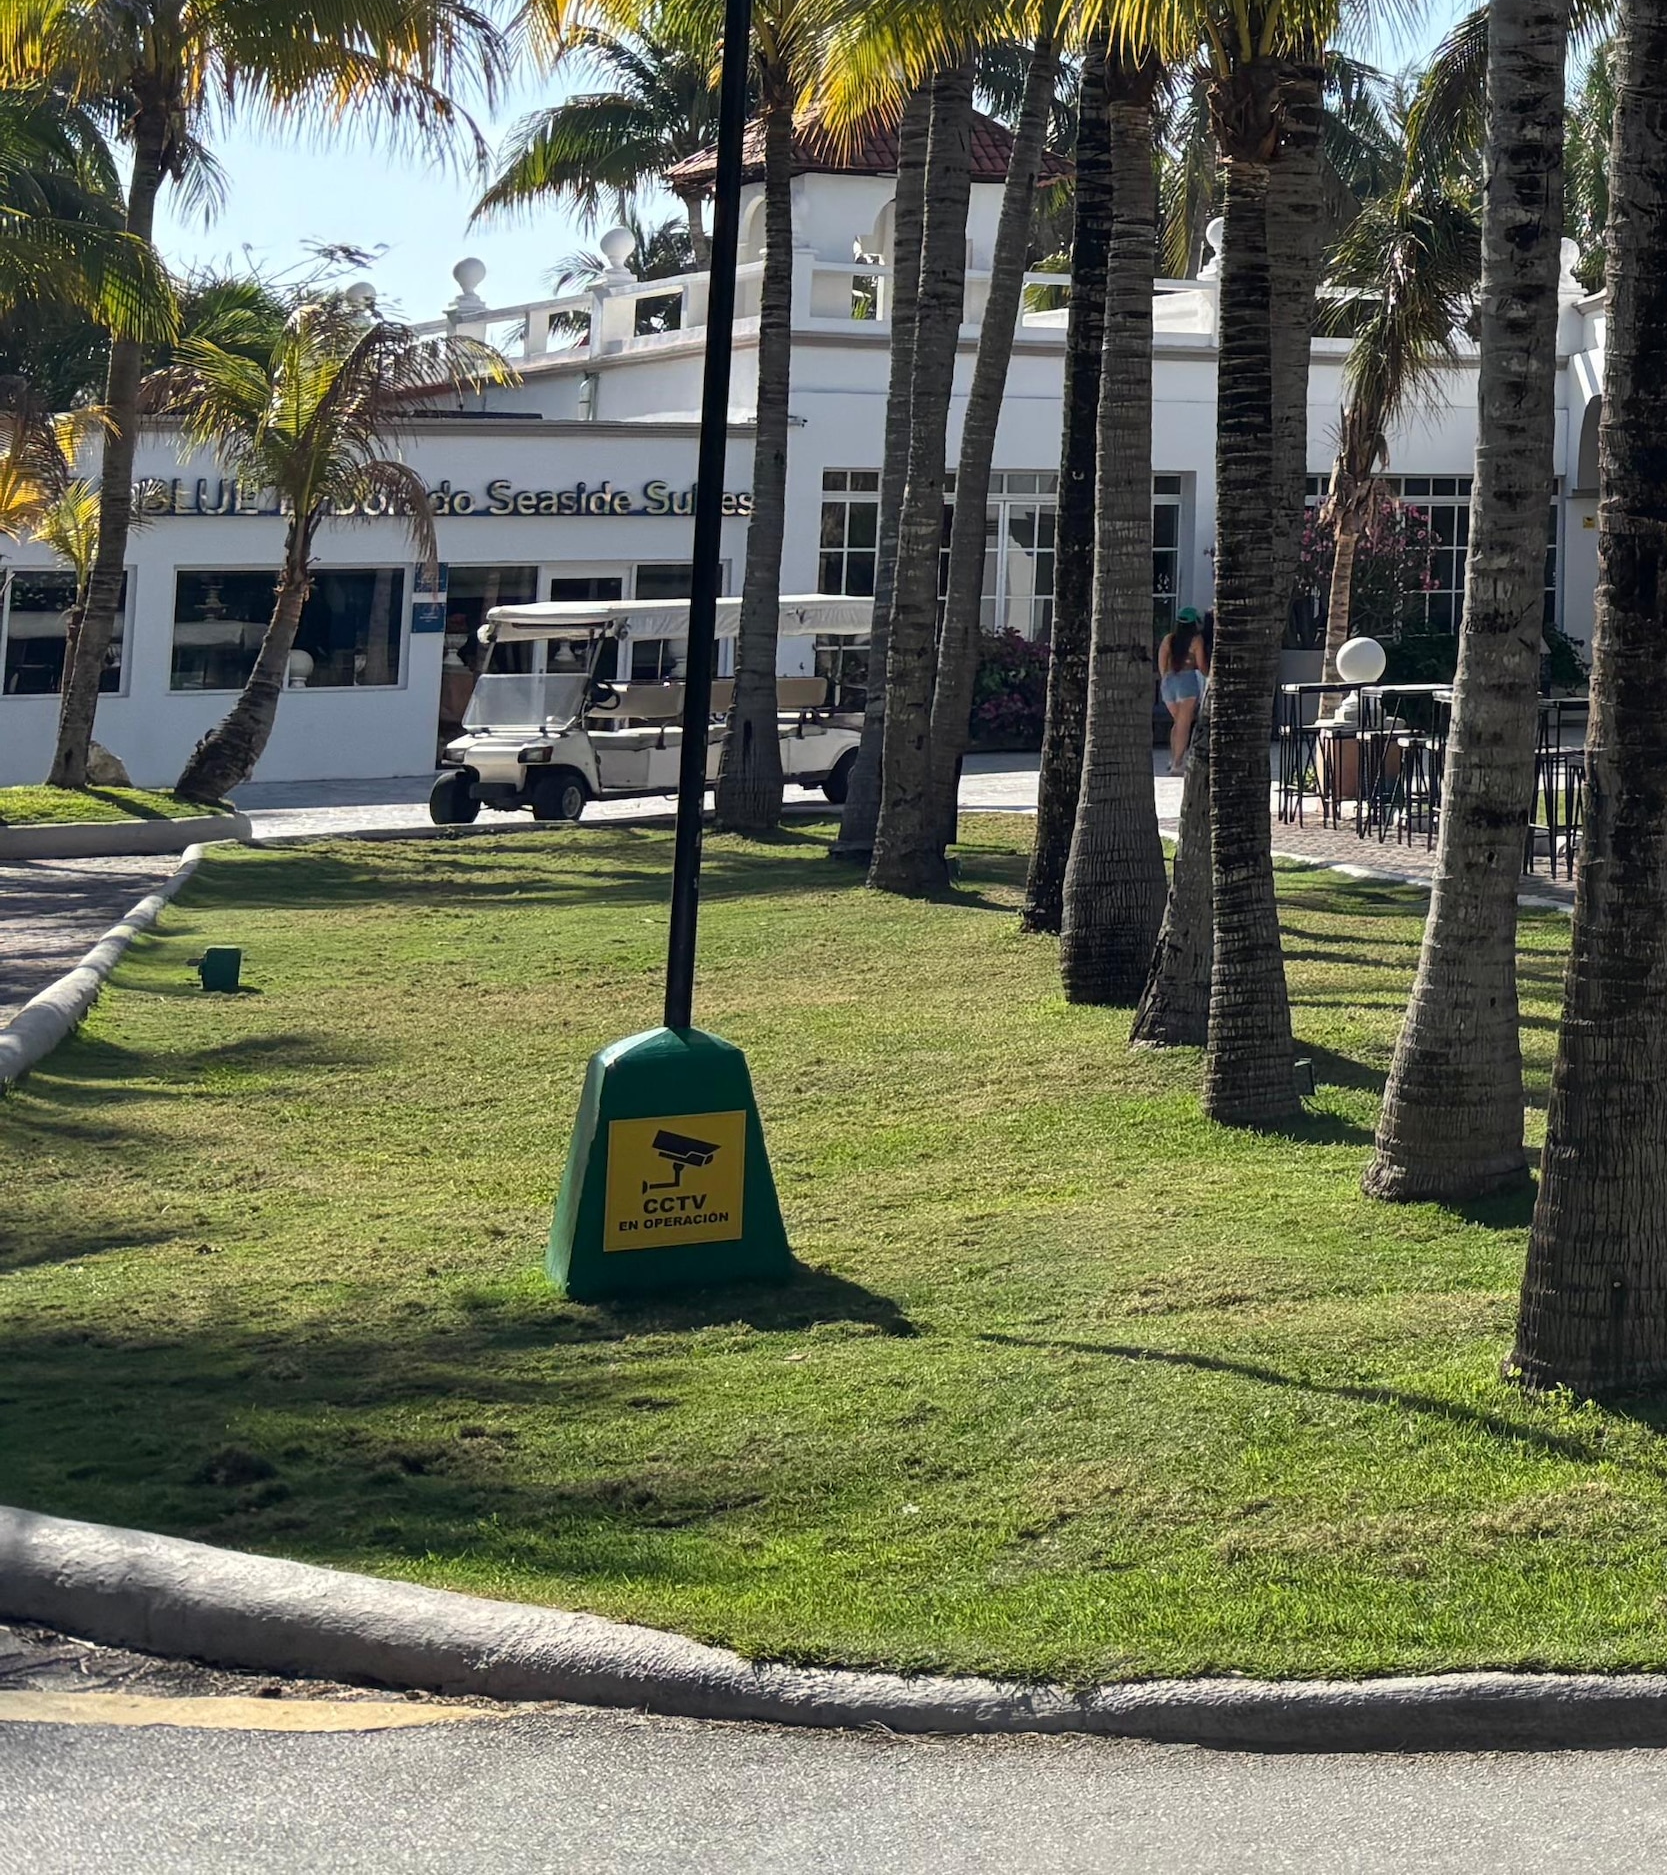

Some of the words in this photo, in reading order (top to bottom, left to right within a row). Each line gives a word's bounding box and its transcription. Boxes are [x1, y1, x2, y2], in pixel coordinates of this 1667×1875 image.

[487, 479, 632, 515] Seaside
[643, 480, 754, 515] Suies
[643, 1194, 707, 1214] CCTV
[618, 1220, 638, 1231] EN
